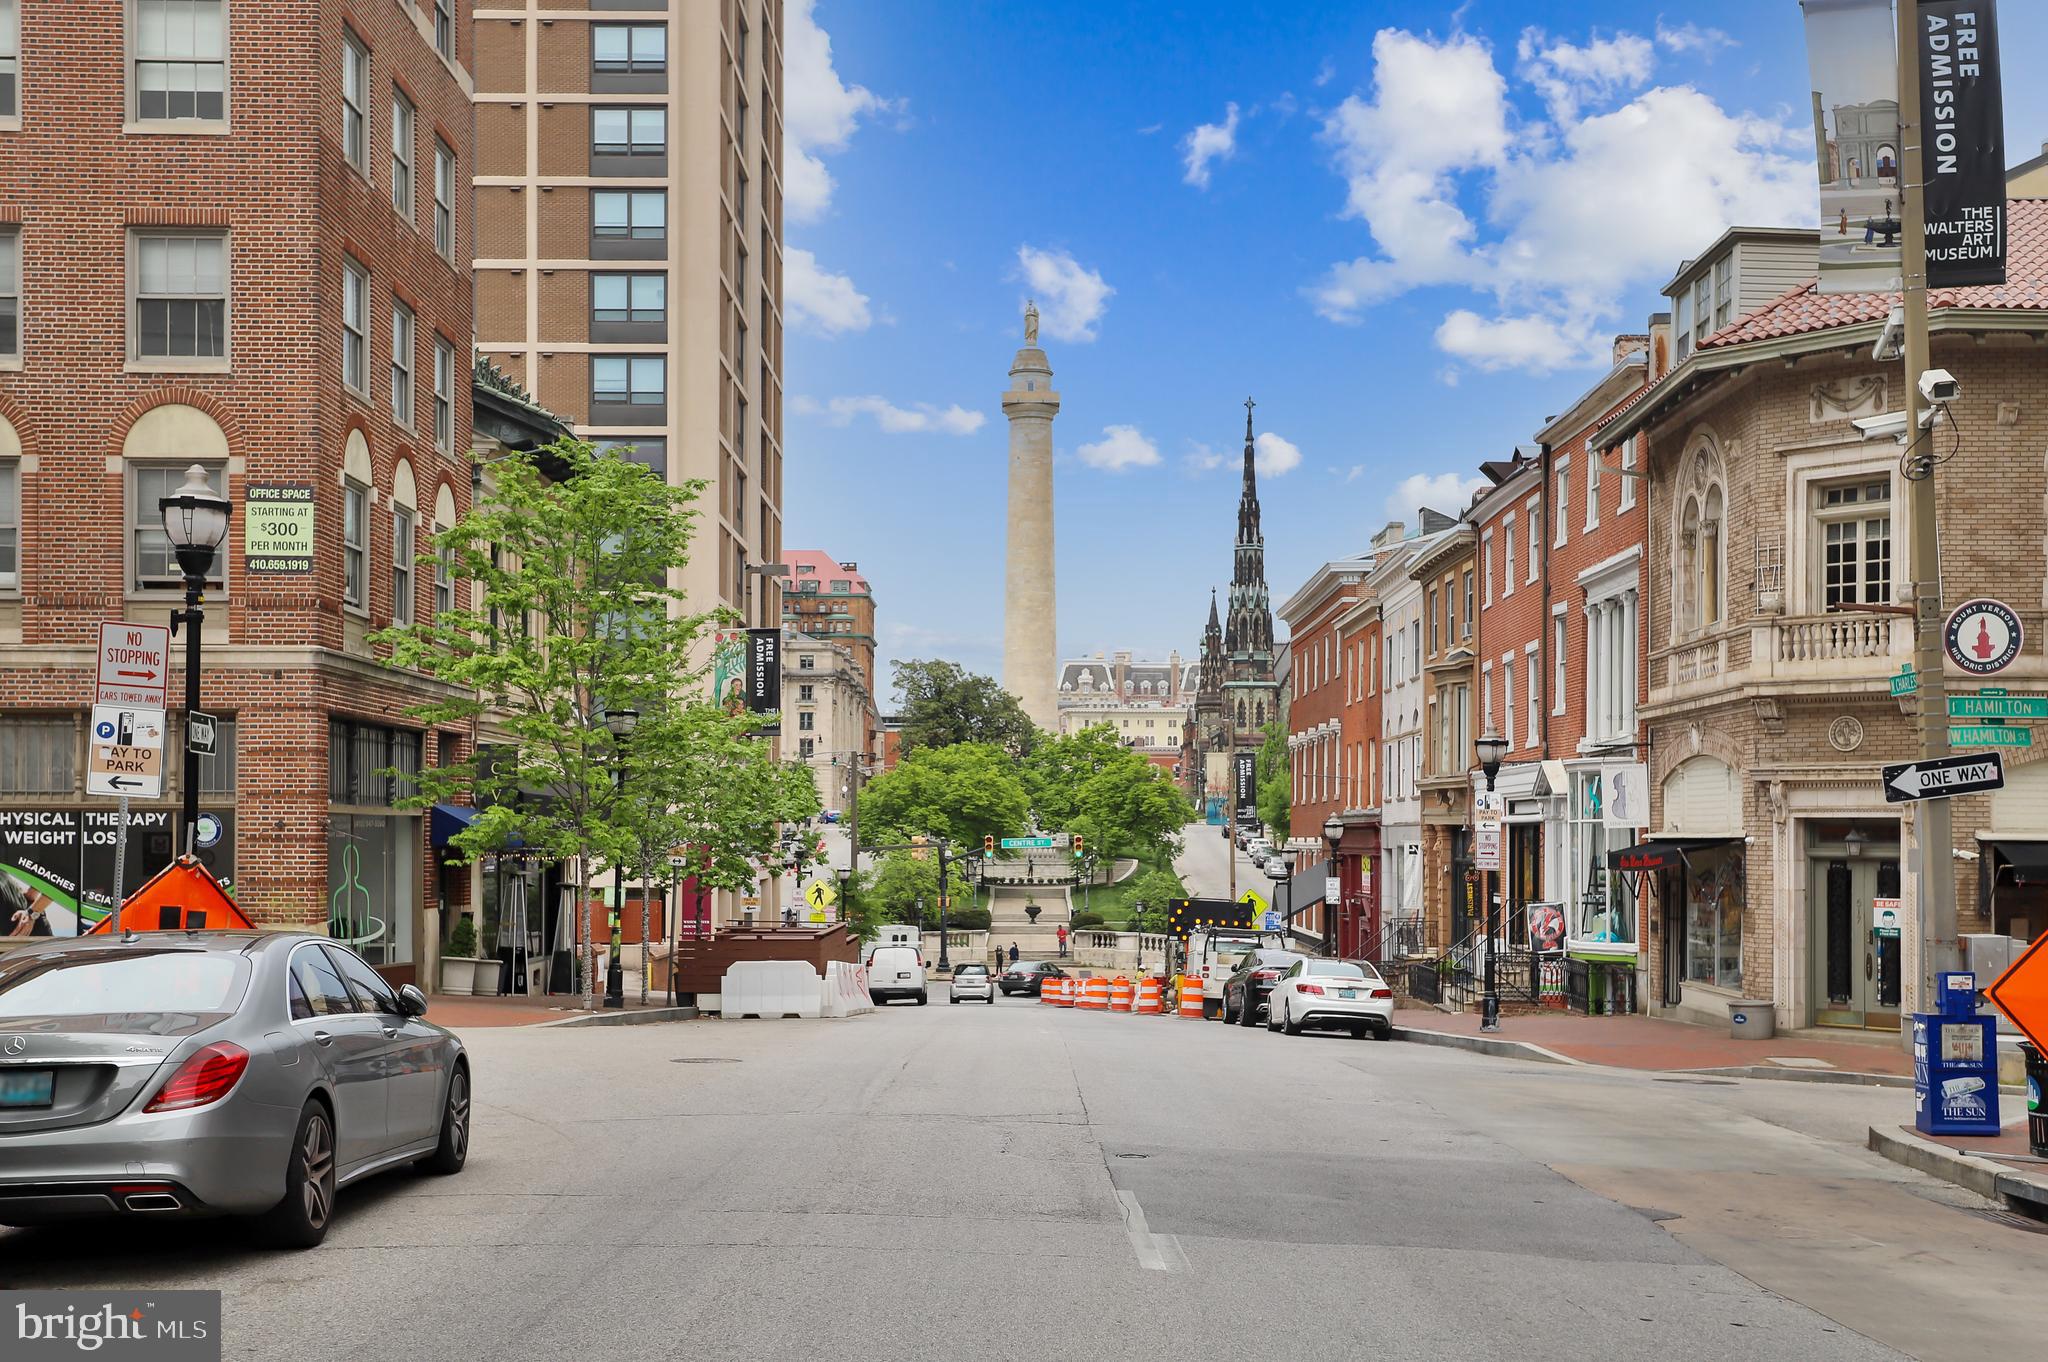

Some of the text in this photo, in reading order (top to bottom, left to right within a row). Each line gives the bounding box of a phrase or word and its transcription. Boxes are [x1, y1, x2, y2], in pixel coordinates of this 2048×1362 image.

[1955, 12, 1980, 77] FREE
[1927, 15, 1957, 174] ADMISSION
[1961, 206, 1993, 219] THE
[1923, 219, 1994, 235] WALTERS
[1962, 232, 1994, 246] ART
[1924, 246, 1993, 261] MUSEUM
[249, 488, 311, 499] OFFICE SPACE
[251, 507, 308, 516] STARTING AT
[260, 522, 298, 536] $300
[251, 541, 308, 551] PER MONTH
[249, 559, 309, 570] 410.659.1919
[1951, 604, 2015, 630] MOUNT VERNON
[126, 631, 143, 647] NO
[107, 648, 160, 666] STOPPING
[765, 637, 774, 663] FREE
[1951, 644, 2016, 671] HISTORIC DISTRICT
[755, 637, 765, 697] ADMISSION
[100, 690, 162, 704] CARS TOWED AWAY
[1965, 699, 2032, 714] HAMILTON
[102, 746, 152, 760] AY TO
[106, 759, 144, 773] PARK
[1920, 765, 1988, 787] ONE WAY
[4, 831, 128, 845] WEIGHT LOS
[1009, 839, 1035, 847] CENTRE
[1478, 842, 1498, 850] STOPPING
[18, 856, 76, 892] HEADACHES
[1943, 1107, 1986, 1116] THE SUN
